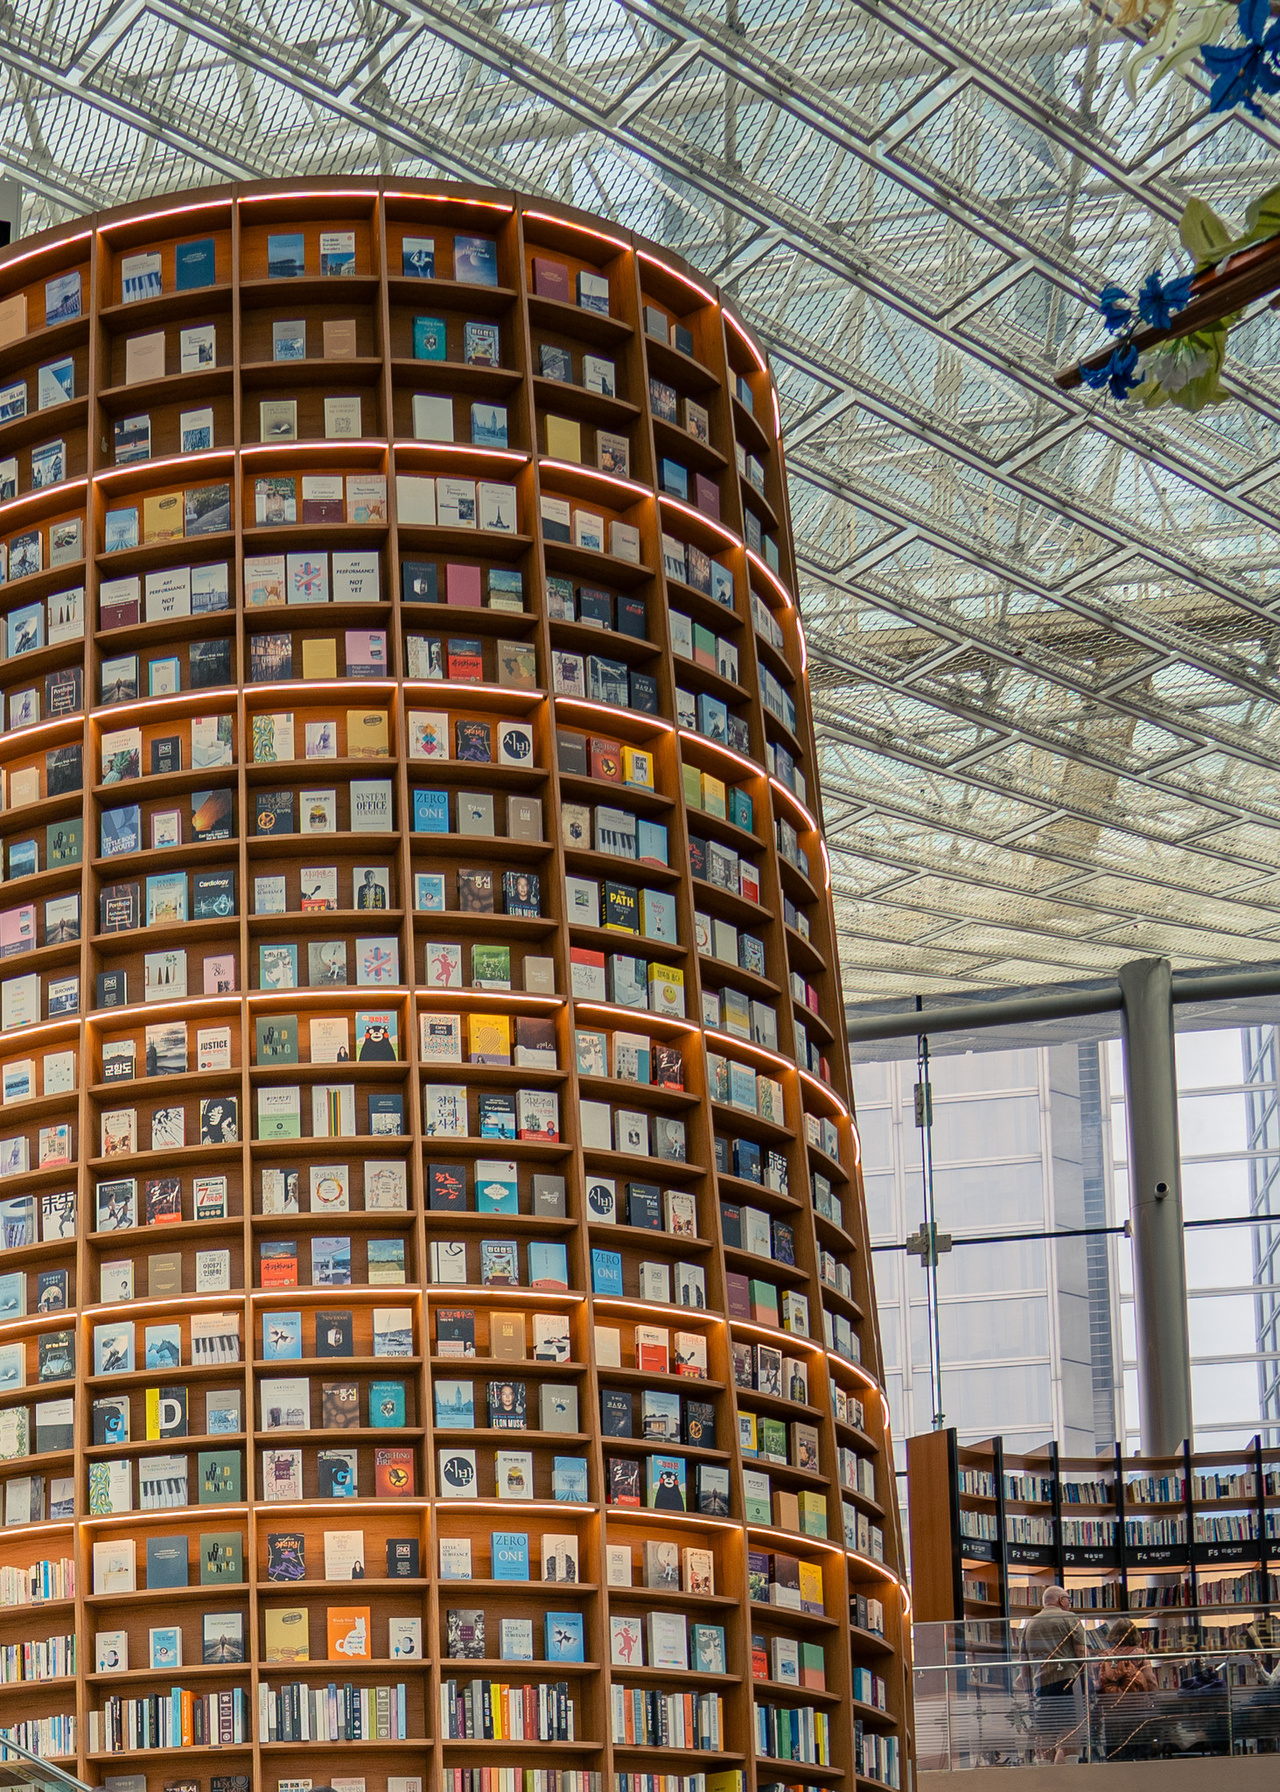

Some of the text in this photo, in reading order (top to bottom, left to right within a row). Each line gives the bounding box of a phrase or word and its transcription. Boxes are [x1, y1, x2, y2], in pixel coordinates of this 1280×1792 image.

[149, 585, 186, 595] PERFORMANCE
[356, 793, 386, 801] SYSTEM
[416, 792, 446, 804] ZERO
[356, 801, 387, 810] OFFICE
[419, 807, 444, 819] ONE
[304, 870, 334, 878] 사피엔스
[199, 878, 229, 888] Cardiology
[475, 876, 490, 889] 통섭
[610, 893, 634, 908] PATH
[509, 906, 540, 917] ELON MUSK
[368, 1016, 389, 1024] 쿠마몬
[200, 1040, 228, 1050] JUSTICE
[104, 1062, 132, 1077] 군함도
[525, 1099, 554, 1108] 자본주의
[595, 1252, 620, 1266] ZERO
[598, 1268, 619, 1280] ONE
[340, 1388, 357, 1401] 통섭
[493, 1419, 524, 1428] ELON MUSK
[496, 1535, 526, 1546] ZERO
[499, 1550, 524, 1561] ONE
[1012, 1550, 1020, 1558] F2
[1065, 1553, 1075, 1561] F3
[1138, 1552, 1147, 1560] F4
